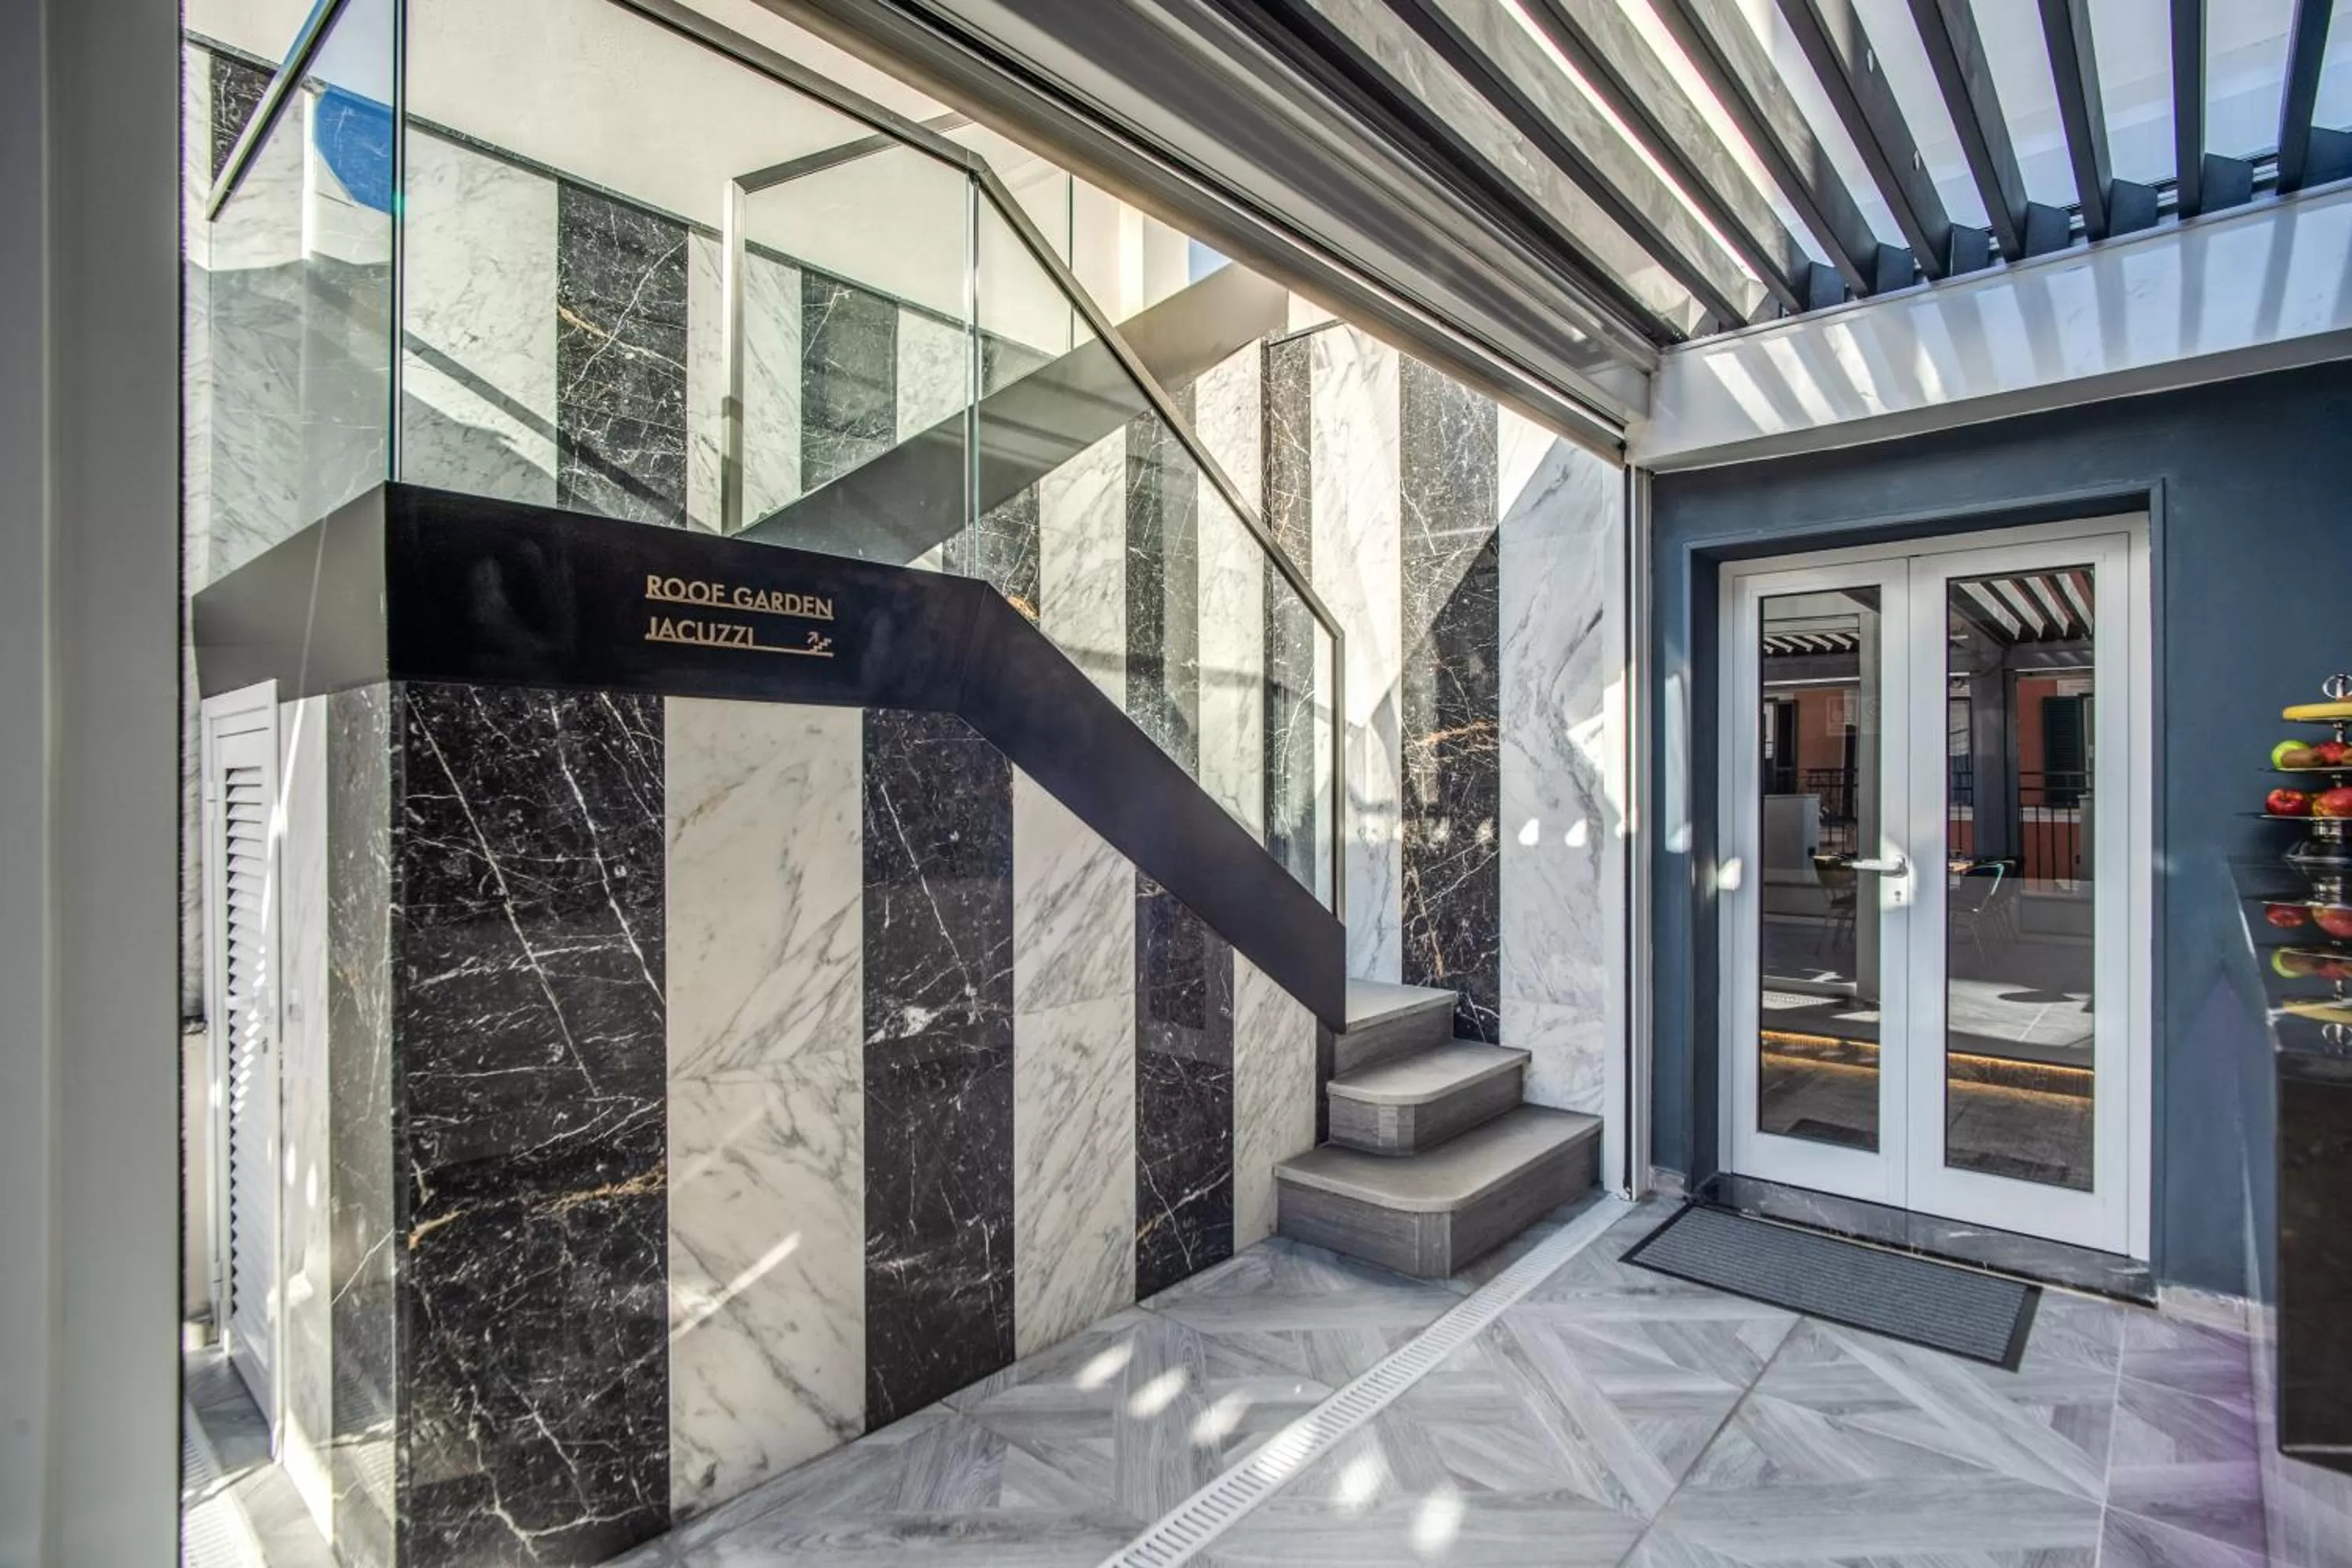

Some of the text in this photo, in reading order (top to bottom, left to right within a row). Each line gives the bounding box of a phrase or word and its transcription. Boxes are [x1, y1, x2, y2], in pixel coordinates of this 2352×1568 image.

[646, 575, 833, 617] ROOF GARDEN
[646, 616, 753, 646] JACUZZI
